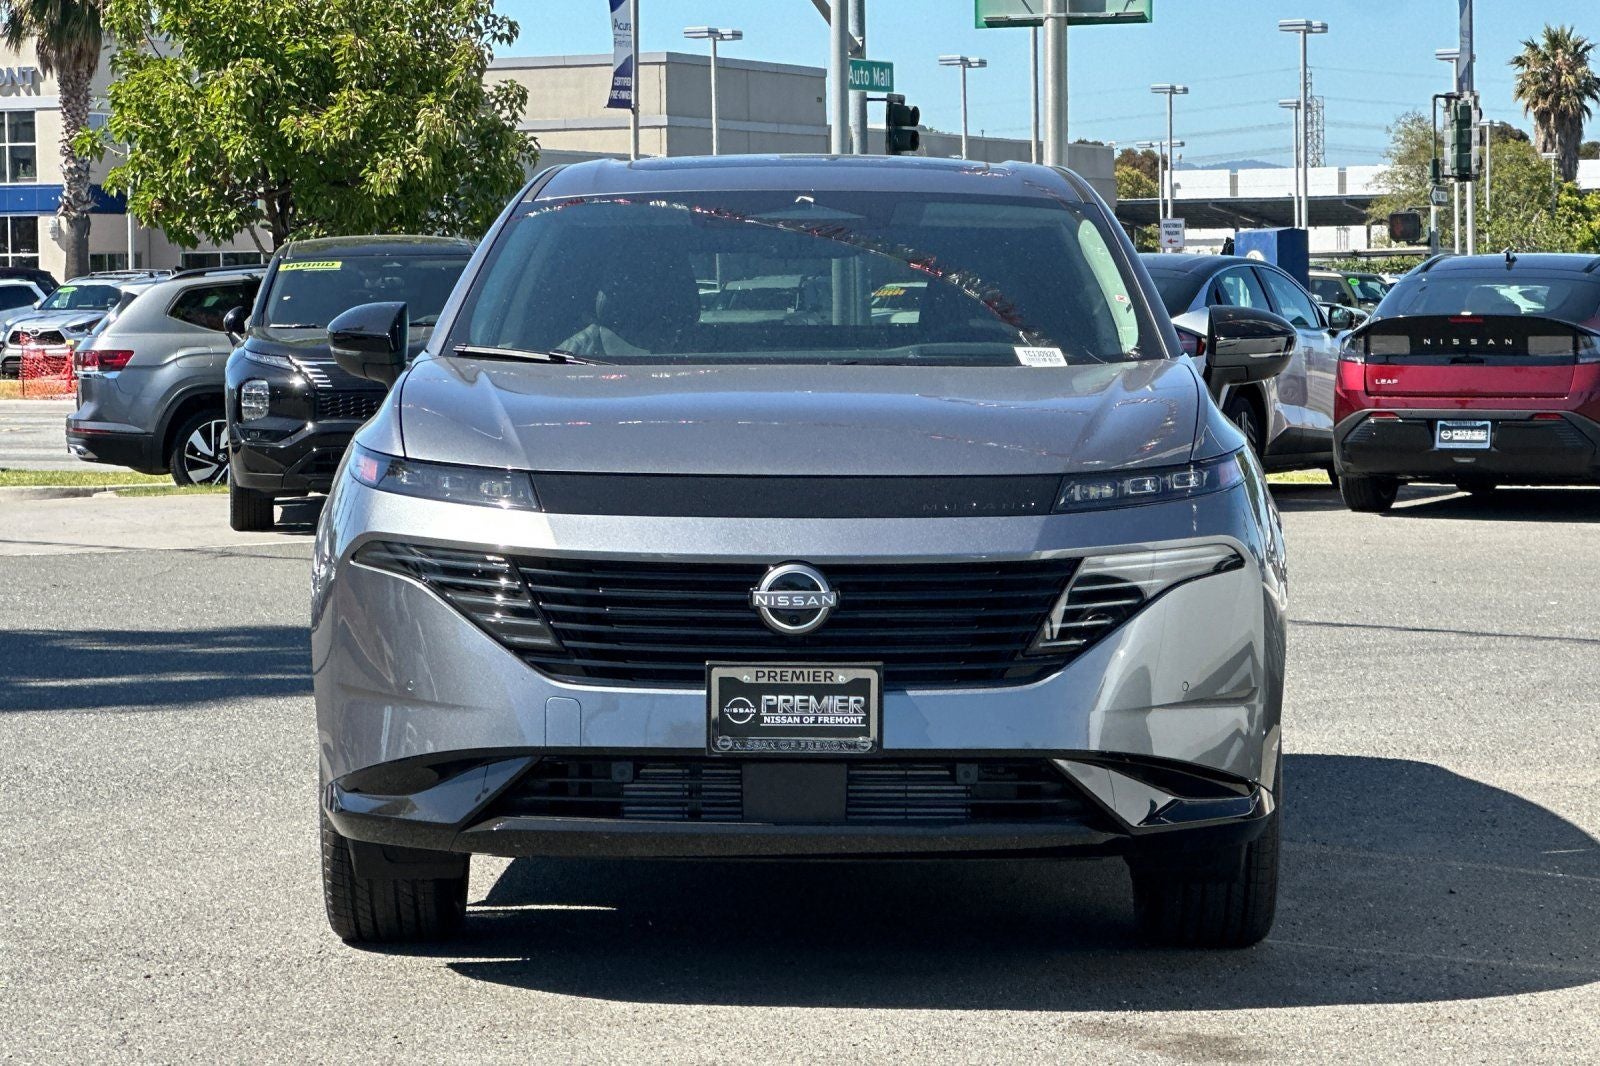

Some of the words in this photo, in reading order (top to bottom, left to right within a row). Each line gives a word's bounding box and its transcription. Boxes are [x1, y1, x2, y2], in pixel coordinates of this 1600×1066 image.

[849, 65, 869, 85] Auto
[873, 67, 890, 87] Mall
[755, 594, 834, 606] NISSAN
[755, 670, 834, 682] PREMIER
[761, 695, 865, 714] PREMIER
[763, 716, 801, 724] NISSAN
[802, 716, 815, 724] OF
[818, 716, 863, 724] FREMONT
